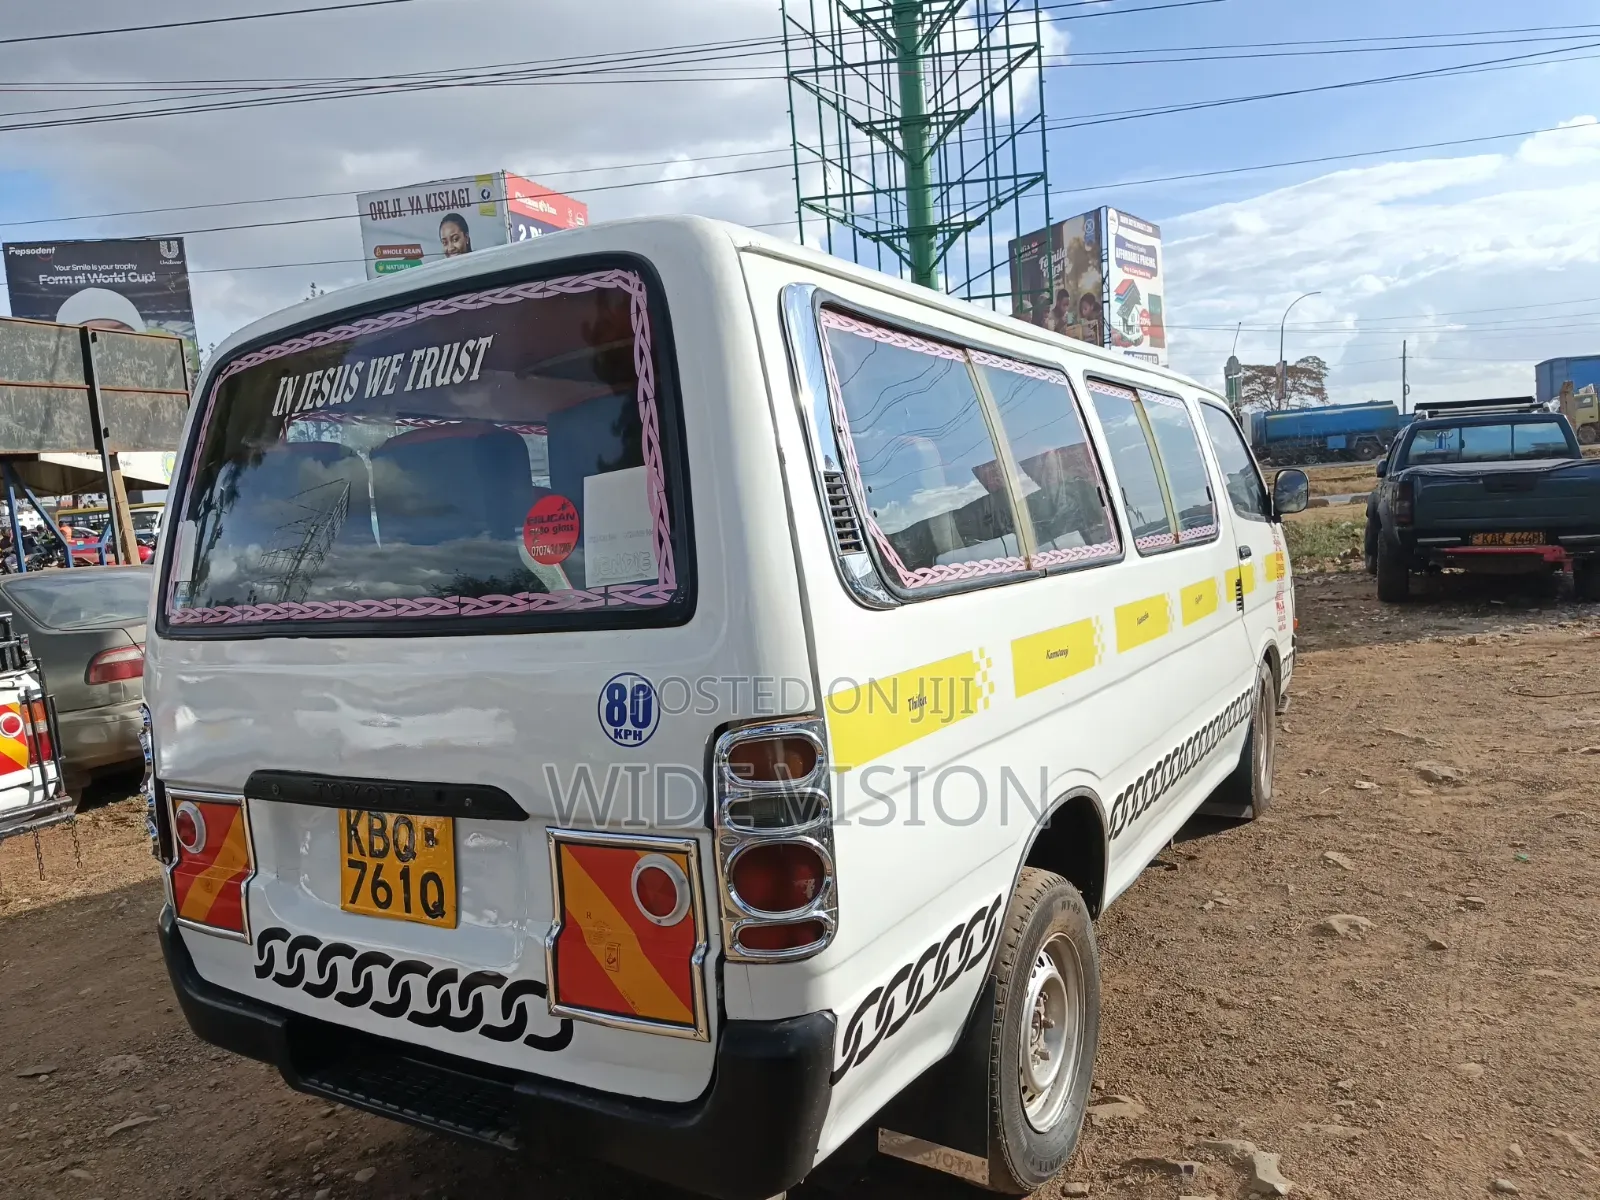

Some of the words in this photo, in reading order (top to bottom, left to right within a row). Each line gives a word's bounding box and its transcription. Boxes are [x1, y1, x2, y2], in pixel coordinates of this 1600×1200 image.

[408, 195, 424, 216] YA
[425, 187, 472, 213] KISIAGI
[8, 246, 56, 257] Pepsodent
[159, 258, 184, 266] Unilever
[39, 274, 73, 285] Form
[75, 272, 86, 284] ni
[87, 271, 126, 284] World
[127, 270, 157, 285] Cup!
[54, 263, 72, 271] Your
[72, 263, 91, 271] Smile
[115, 262, 138, 271] trophy
[271, 375, 301, 417] IN
[294, 360, 366, 413] JESUS
[364, 352, 405, 399] WE
[403, 334, 495, 393] TRUST
[552, 523, 574, 535] glass
[605, 682, 653, 729] 80
[613, 728, 643, 741] KPH
[312, 779, 416, 804] TOYOTA
[346, 809, 417, 863] KBQ
[346, 858, 446, 920] 761Q
[919, 1149, 977, 1174] OYOTA
